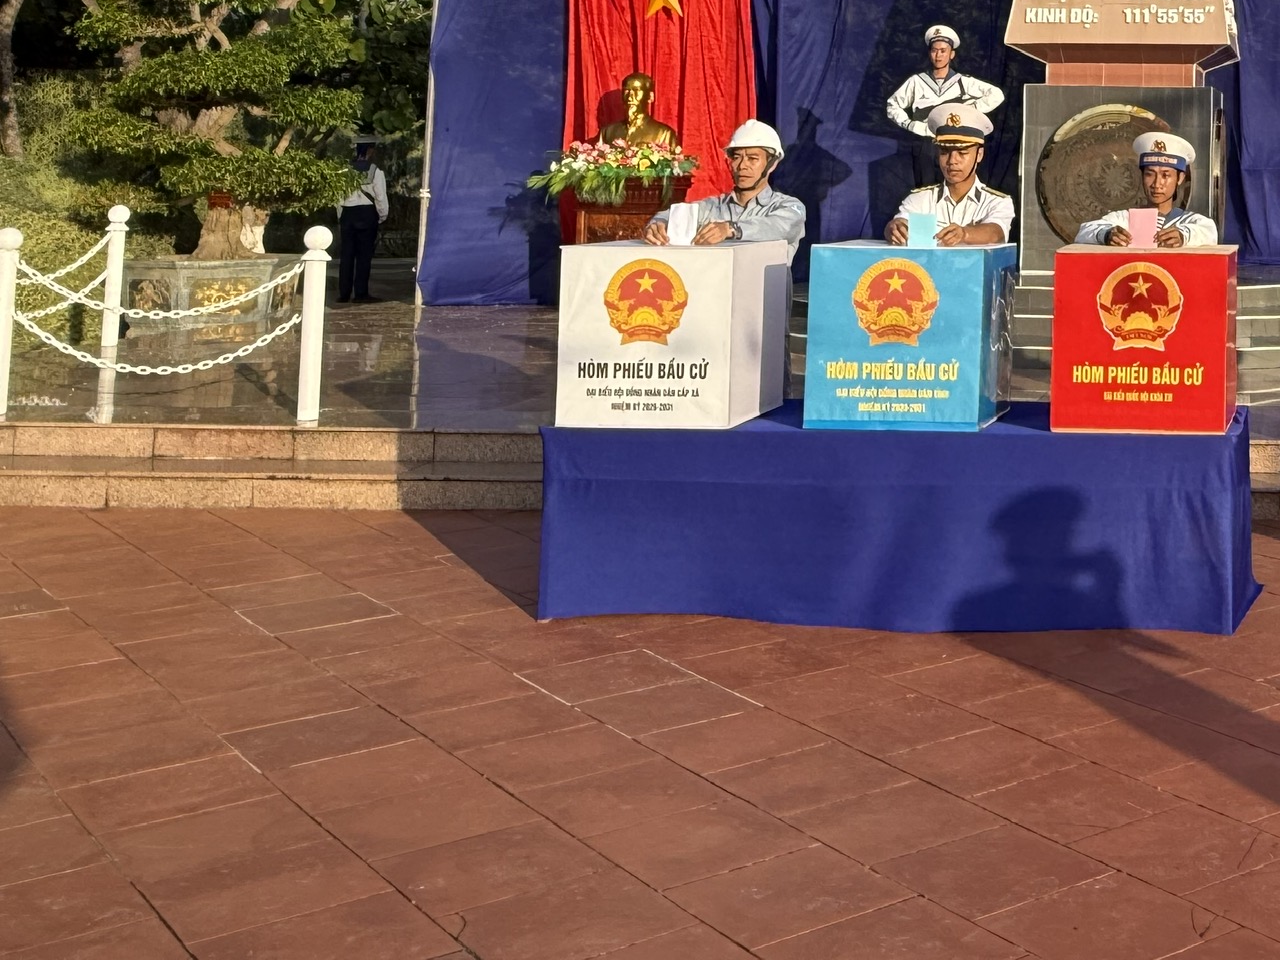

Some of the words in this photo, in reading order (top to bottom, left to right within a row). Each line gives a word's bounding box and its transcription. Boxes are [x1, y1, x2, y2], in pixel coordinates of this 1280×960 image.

[1025, 8, 1066, 23] KINH
[1070, 4, 1098, 28] ĐỘ:
[578, 358, 609, 379] HÒM
[613, 357, 653, 379] PHIẾU
[690, 357, 709, 380] CỬ
[826, 357, 858, 380] HÒM
[862, 357, 903, 380] PHIẾU
[939, 358, 960, 381] CỬ
[1073, 361, 1104, 384] HÒM
[1108, 361, 1148, 384] PHIẾU
[1184, 362, 1204, 386] CỬ
